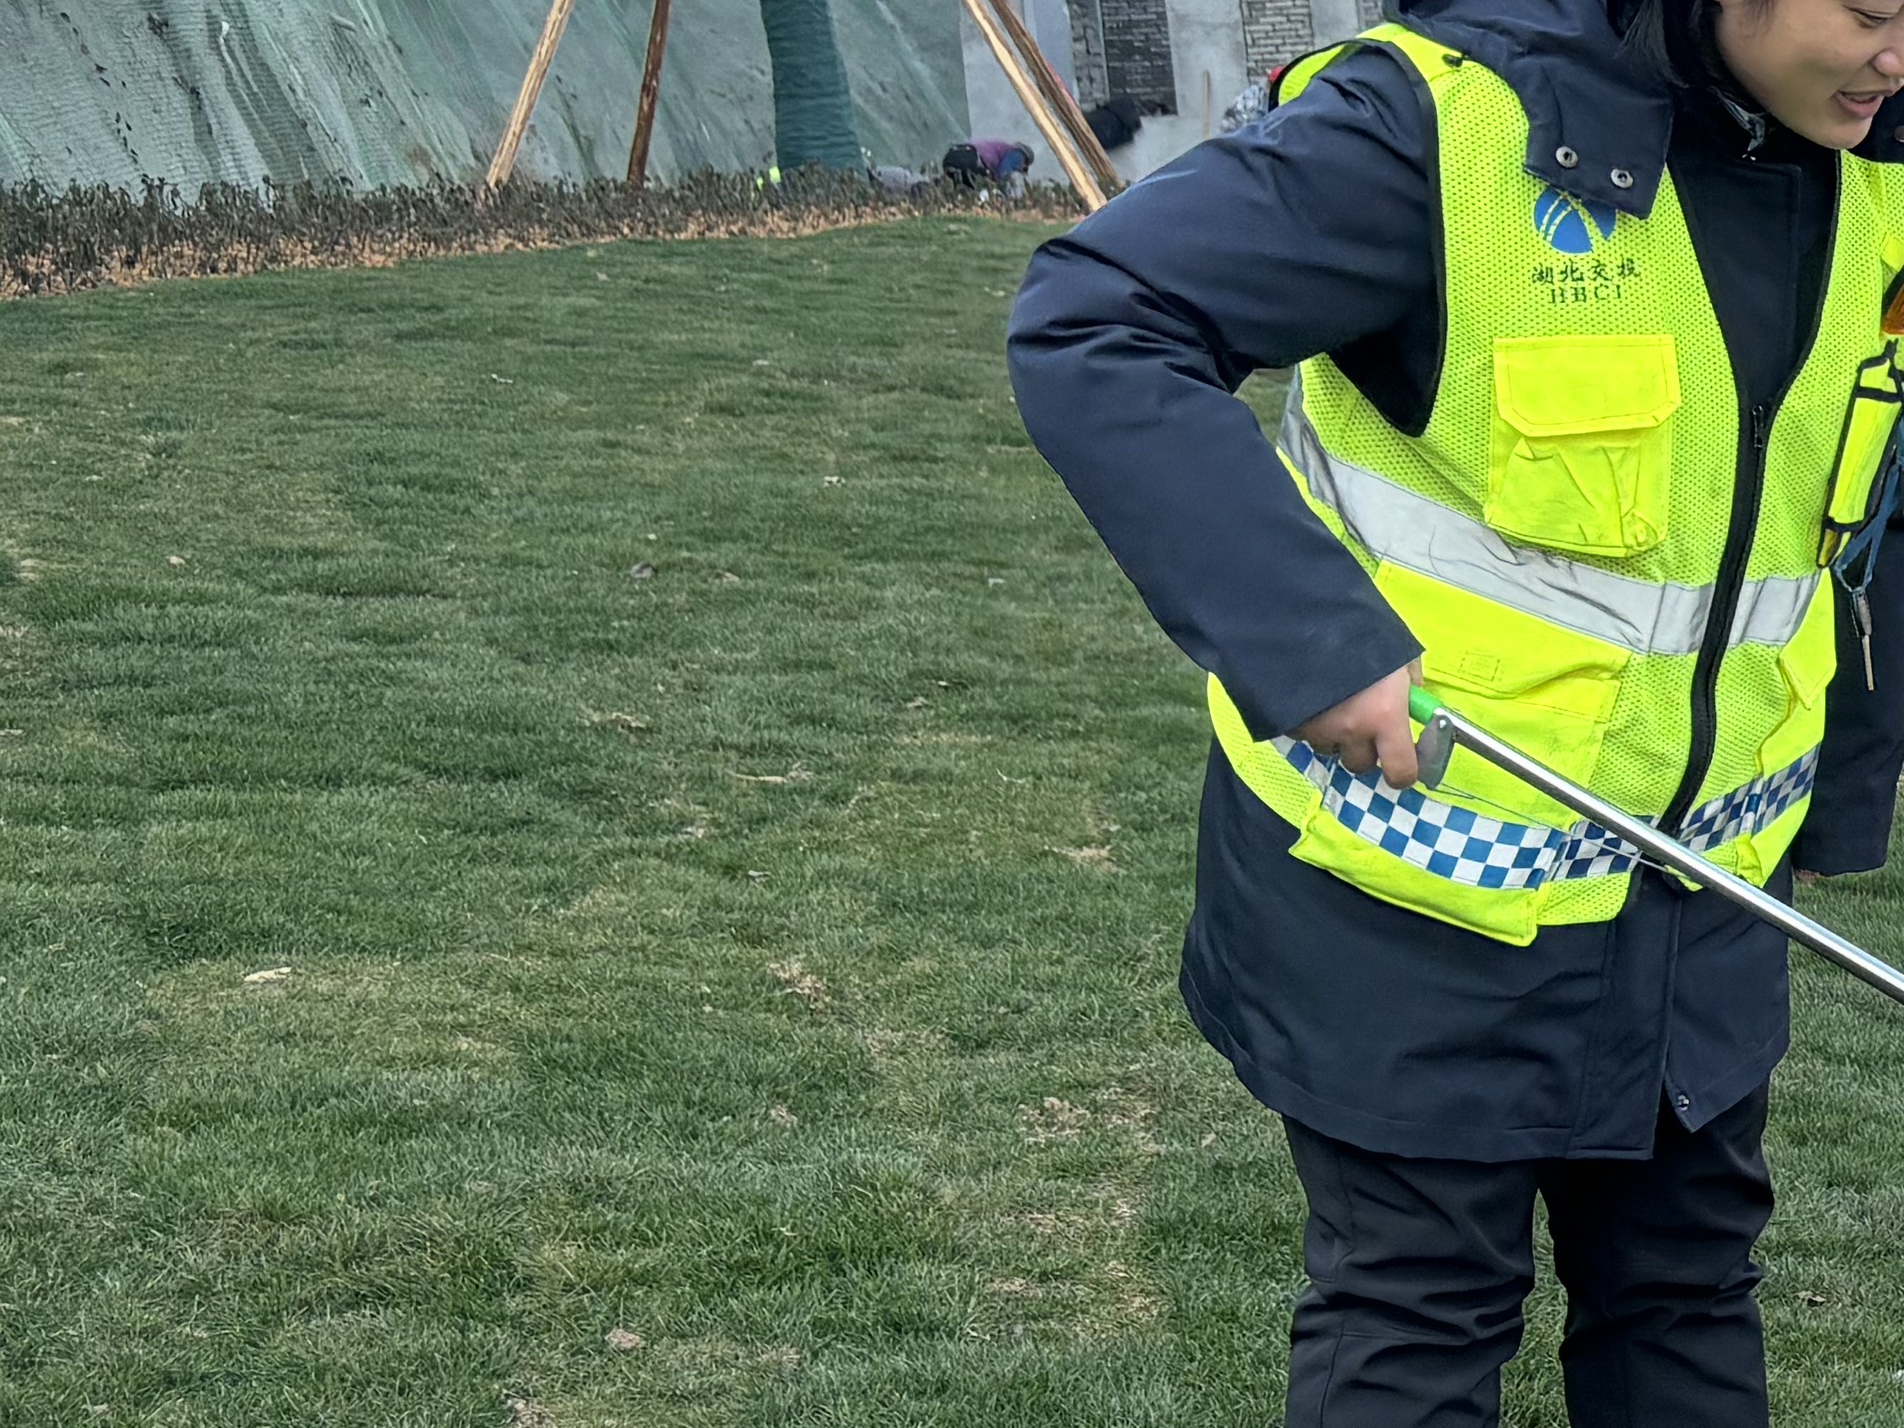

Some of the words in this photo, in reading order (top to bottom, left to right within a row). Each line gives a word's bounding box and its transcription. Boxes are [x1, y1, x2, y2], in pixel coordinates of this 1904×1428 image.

[1531, 257, 1641, 286] 湖北交投
[1547, 284, 1621, 305] HBCI
